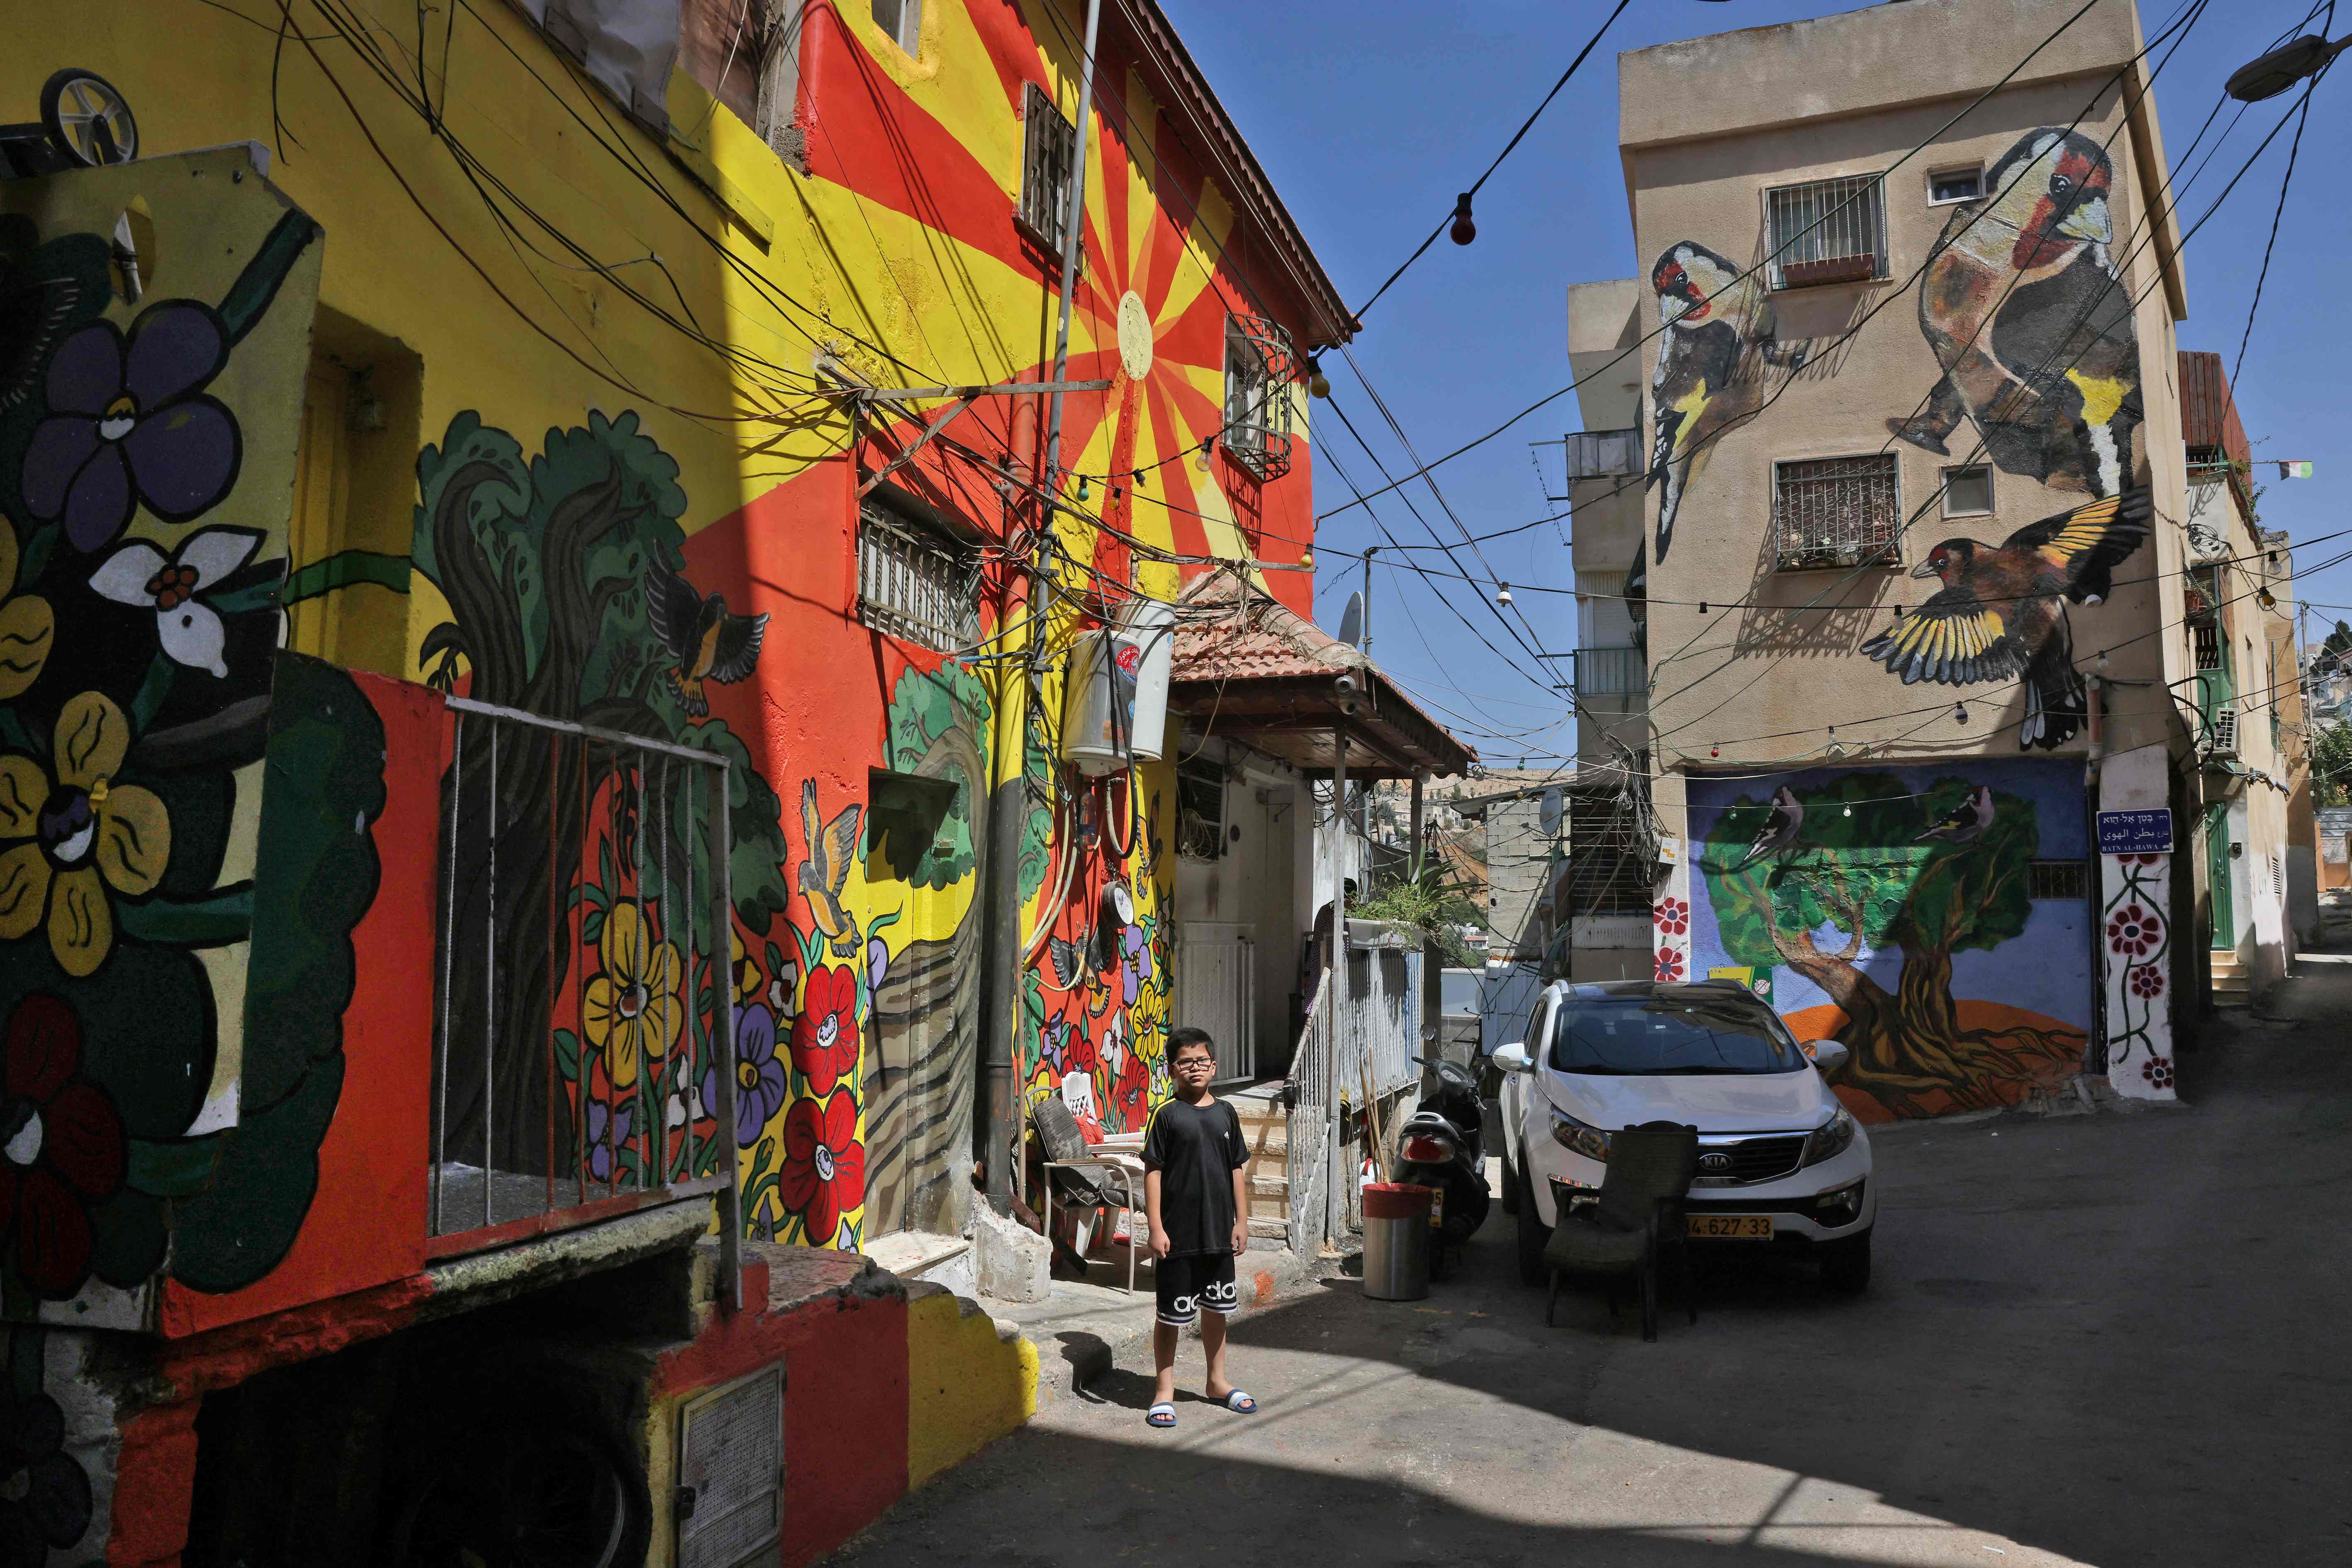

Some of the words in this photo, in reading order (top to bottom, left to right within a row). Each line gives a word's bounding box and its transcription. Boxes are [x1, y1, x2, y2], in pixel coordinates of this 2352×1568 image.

[2104, 829, 2128, 840] الهوى
[2134, 828, 2155, 840] بطن
[1704, 1157, 1728, 1167] KIA
